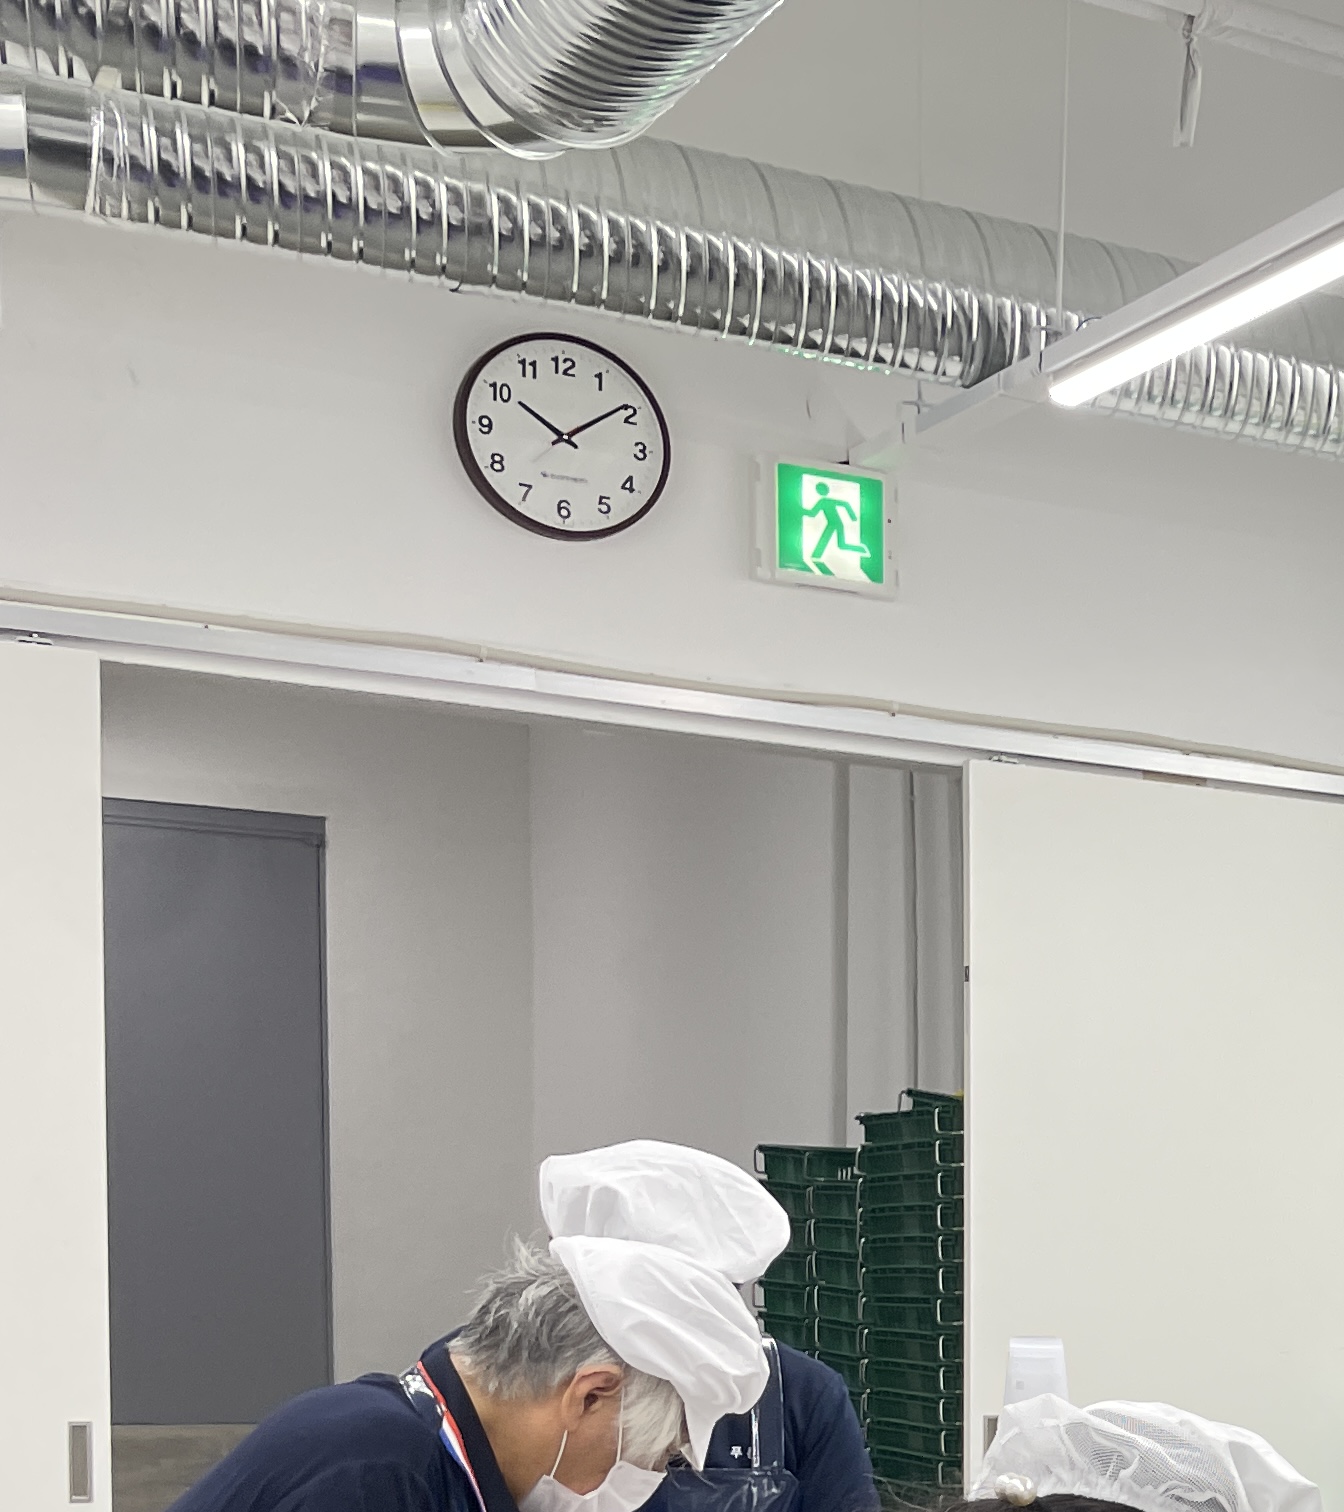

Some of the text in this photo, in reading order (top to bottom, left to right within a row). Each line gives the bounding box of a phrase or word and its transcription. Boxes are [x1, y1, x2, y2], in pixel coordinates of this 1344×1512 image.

[517, 357, 537, 379] 11
[550, 355, 576, 377] 12
[594, 372, 603, 391] 1
[488, 381, 511, 403] 10
[623, 404, 637, 425] 2
[478, 415, 493, 435] 9
[633, 442, 647, 461] 3
[490, 453, 505, 472] 8
[518, 482, 533, 501] 7
[621, 475, 635, 493] 4
[556, 500, 571, 519] 6
[597, 495, 611, 514] 5
